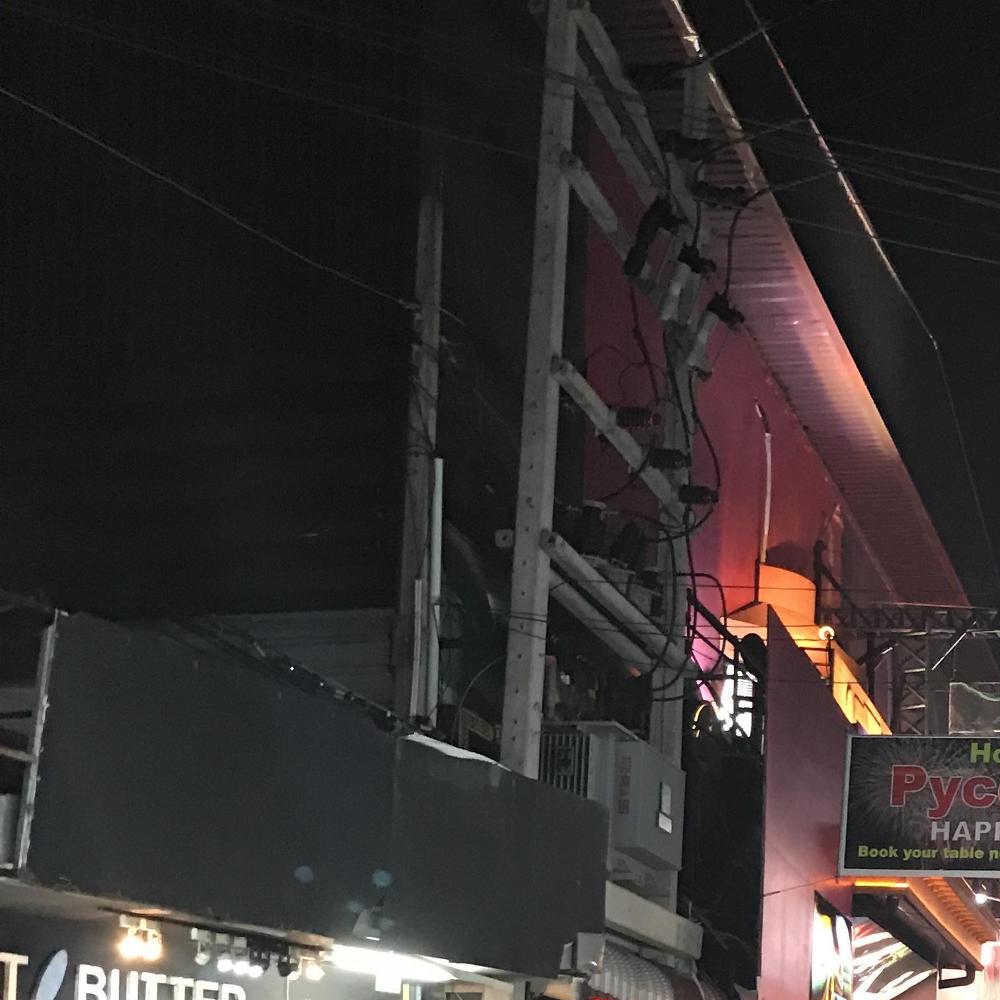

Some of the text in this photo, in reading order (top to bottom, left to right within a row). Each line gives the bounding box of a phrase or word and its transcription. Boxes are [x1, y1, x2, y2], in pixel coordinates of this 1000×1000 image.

[857, 845, 898, 858] Book
[902, 848, 937, 861] your
[943, 846, 984, 859] table
